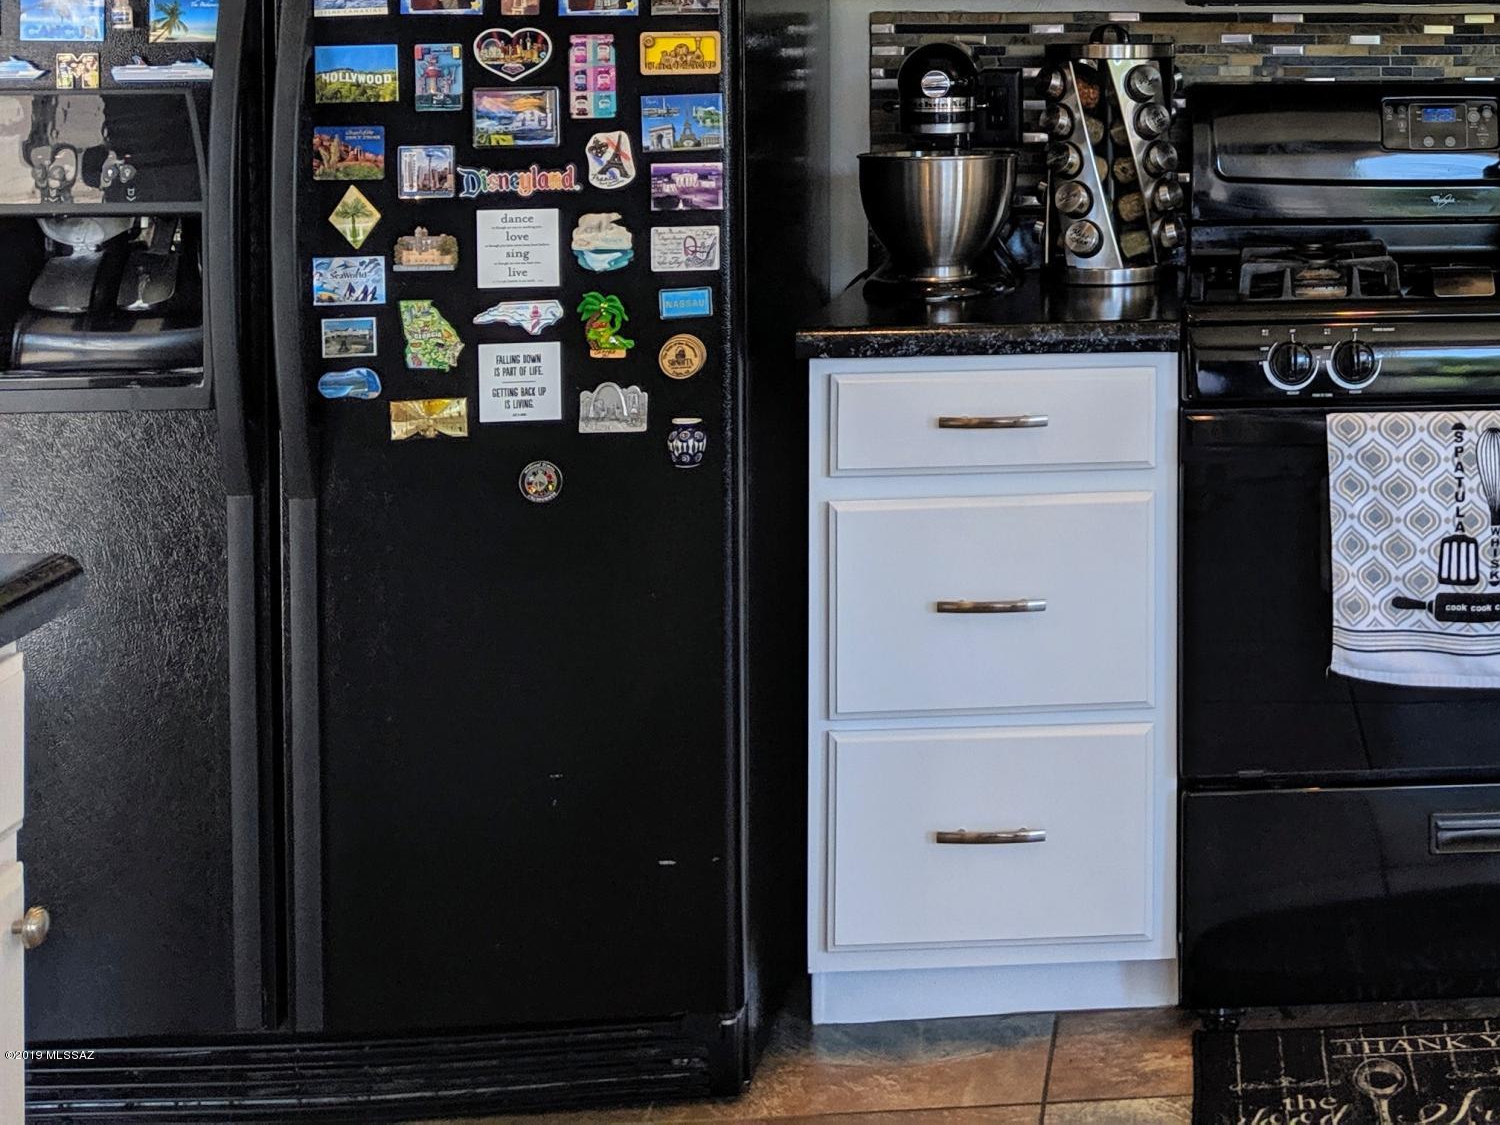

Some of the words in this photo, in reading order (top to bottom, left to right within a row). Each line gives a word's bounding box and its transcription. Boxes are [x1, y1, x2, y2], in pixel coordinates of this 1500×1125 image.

[321, 72, 392, 84] HOLLYWOOD
[457, 164, 577, 198] Disneyland
[501, 213, 534, 224] dance
[506, 231, 529, 241] love
[506, 250, 530, 261] sing
[330, 267, 367, 279] SeaWorld
[508, 267, 528, 277] live
[665, 299, 705, 309] NASSAU
[496, 354, 520, 365] FALLING
[523, 354, 542, 364] DOWN
[494, 367, 500, 377] IS
[502, 366, 517, 377] PART
[519, 366, 527, 376] OF
[529, 366, 544, 376] LIFE.
[492, 387, 518, 398] GETTING
[521, 387, 535, 397] BACK
[538, 386, 547, 396] UP
[505, 400, 511, 409] IS
[512, 399, 534, 409] LIVING.
[1453, 431, 1466, 533] SPATULA
[1489, 527, 1500, 581] WHISK
[1446, 603, 1468, 612] cook
[1471, 603, 1493, 613] cook
[1337, 1036, 1468, 1055] THANK
[1283, 1094, 1338, 1111] the
